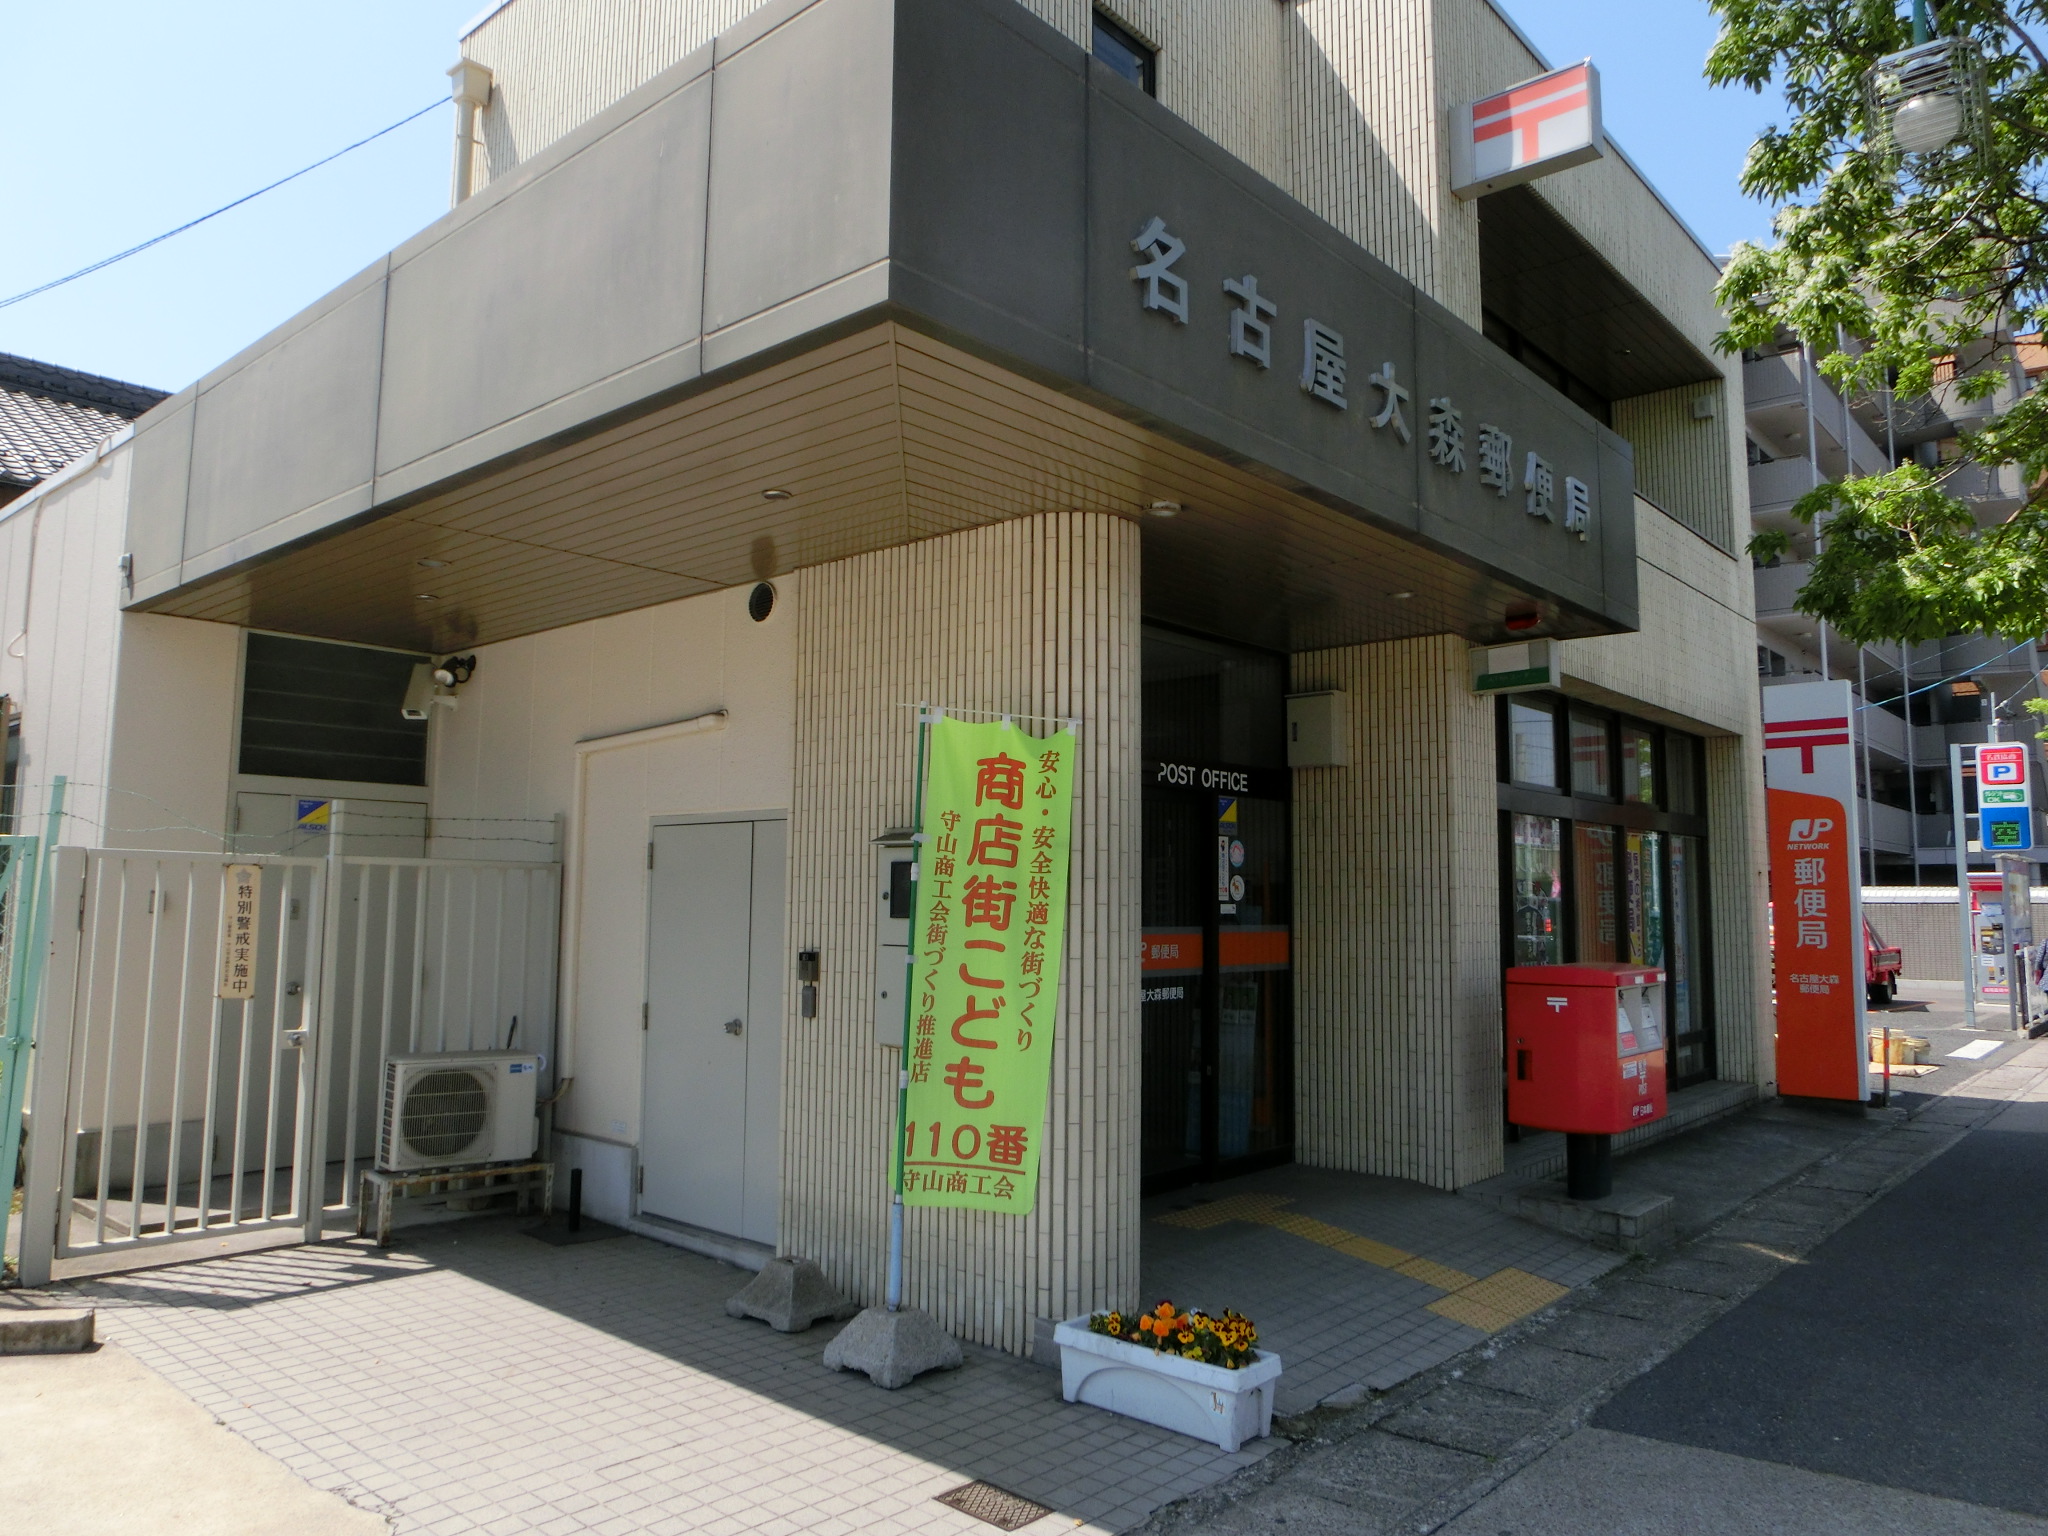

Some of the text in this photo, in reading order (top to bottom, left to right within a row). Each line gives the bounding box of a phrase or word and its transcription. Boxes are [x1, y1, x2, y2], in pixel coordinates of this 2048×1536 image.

[1130, 216, 1591, 542] 名古屋大森郵便局
[1157, 762, 1248, 793] POST OFFICE
[1993, 765, 2011, 779] P
[1788, 818, 1834, 842] JP
[1787, 843, 1830, 851] NETWORK
[1017, 749, 1061, 1052] 安心・安全快適な街づくり
[1793, 857, 1828, 950] 郵便局
[232, 885, 253, 993] 特別警戒実施中
[910, 809, 961, 1084] 守山商工会街づくり推進店
[944, 752, 1027, 1110] 商店街こども
[1151, 944, 1179, 960] 郵便局
[1789, 974, 1840, 985] 名古屋大森
[1799, 984, 1830, 995] 郵便局
[905, 1121, 1029, 1166] 110番
[902, 1168, 1016, 1200] 守山商工会
